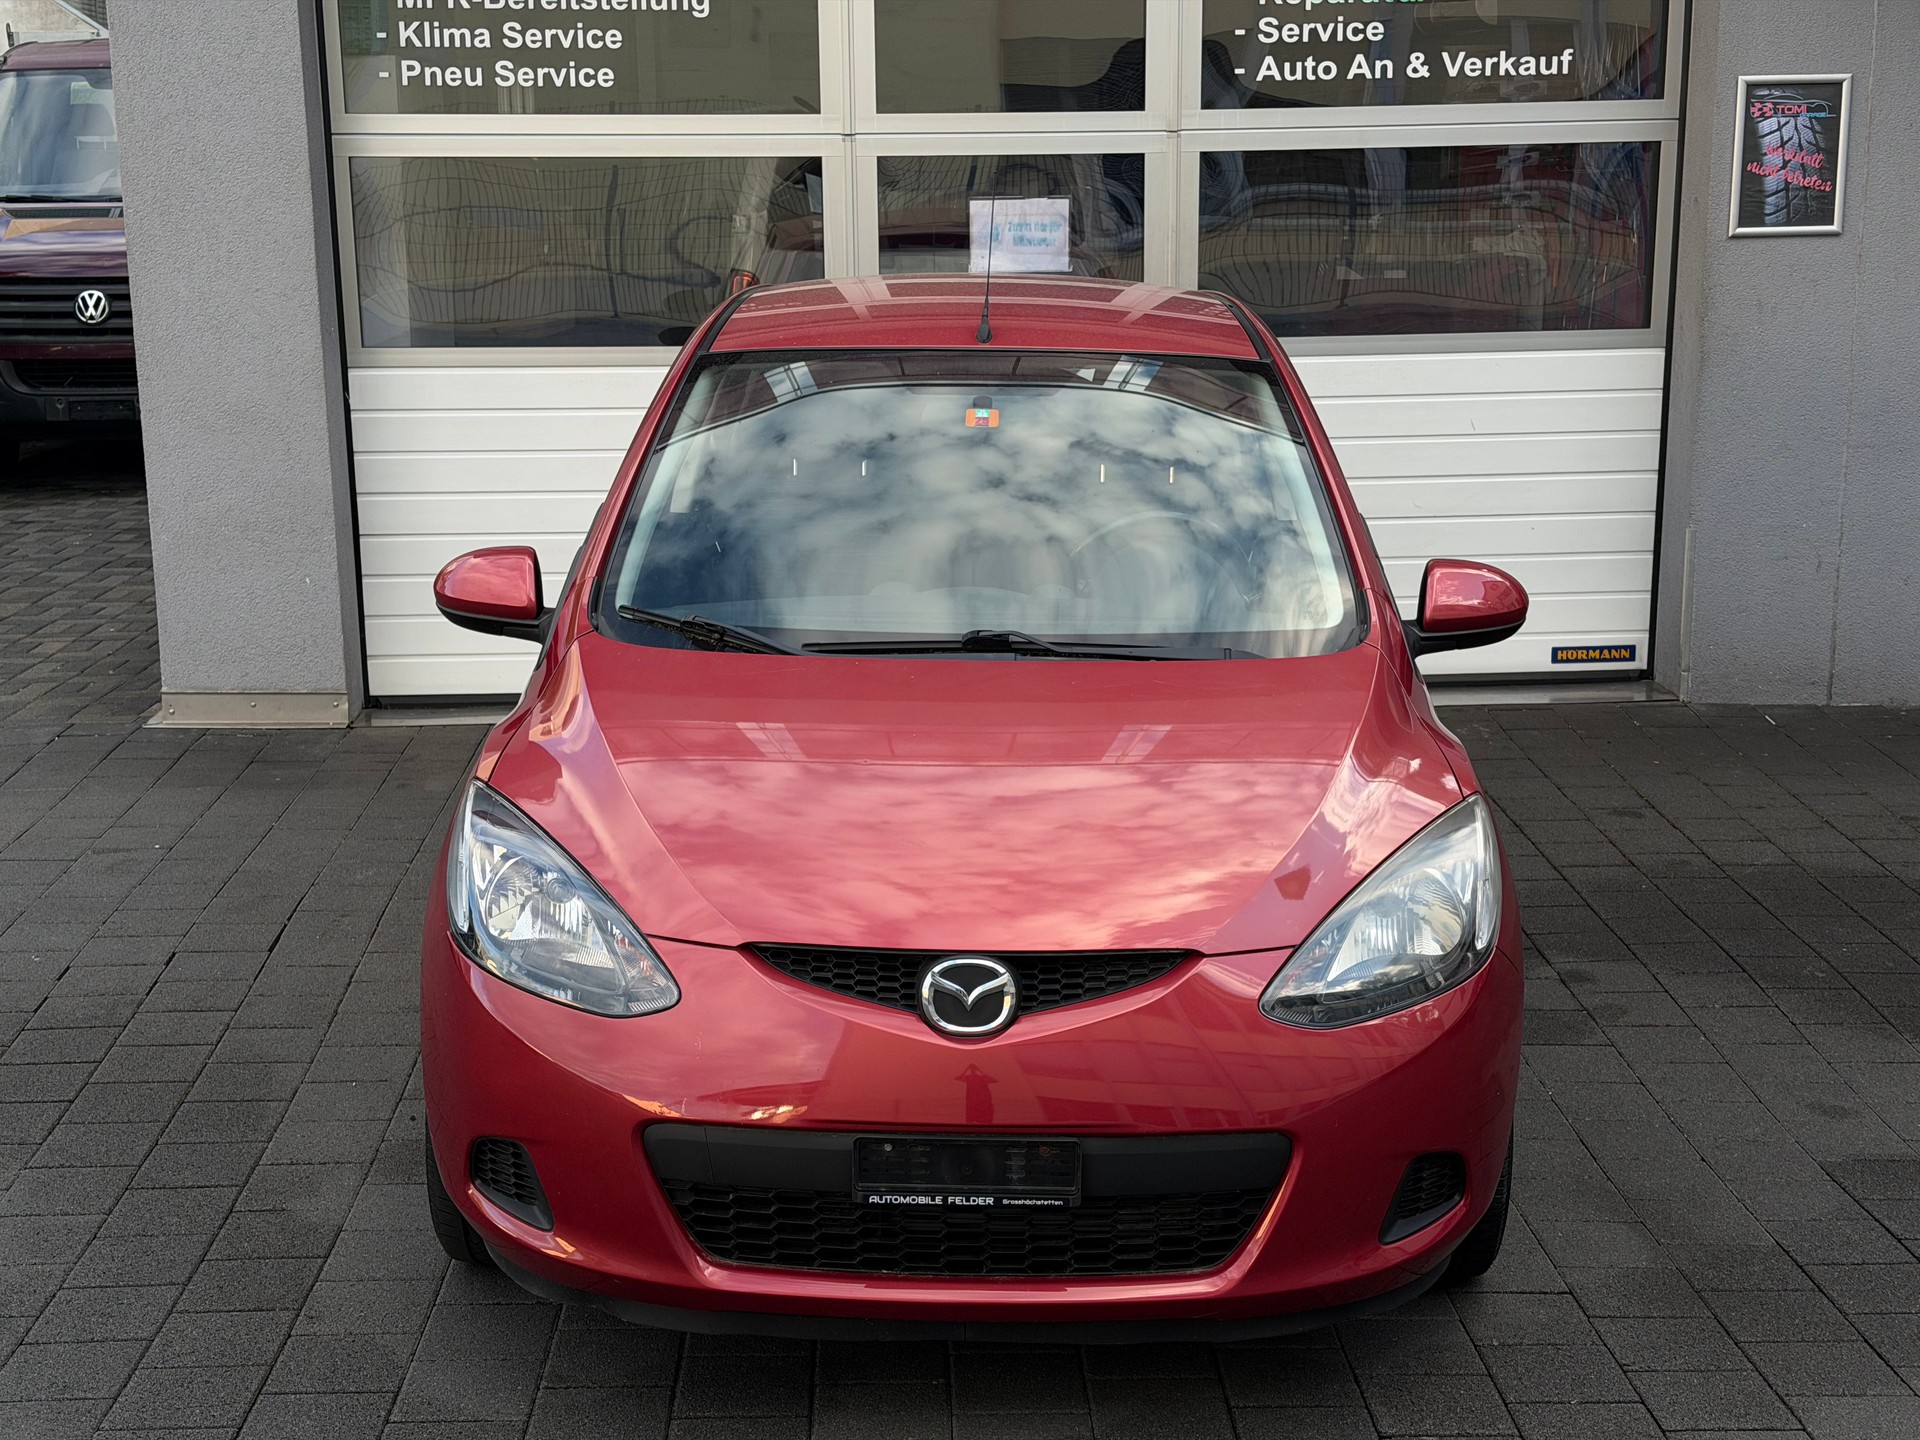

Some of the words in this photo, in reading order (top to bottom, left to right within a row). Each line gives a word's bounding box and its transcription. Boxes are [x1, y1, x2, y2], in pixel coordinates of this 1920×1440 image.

[398, 21, 491, 48] Klima
[502, 22, 623, 49] Service
[1257, 16, 1385, 43] Service
[400, 60, 483, 87] Pneu
[494, 60, 615, 88] Service
[1256, 55, 1338, 82] Auto
[1346, 54, 1393, 80] An
[1406, 52, 1431, 78] &
[1441, 48, 1574, 77] Verkauf
[1782, 167, 1833, 192] betreten
[868, 1195, 943, 1205] AUTOMOBILE
[948, 1196, 994, 1206] FELDER
